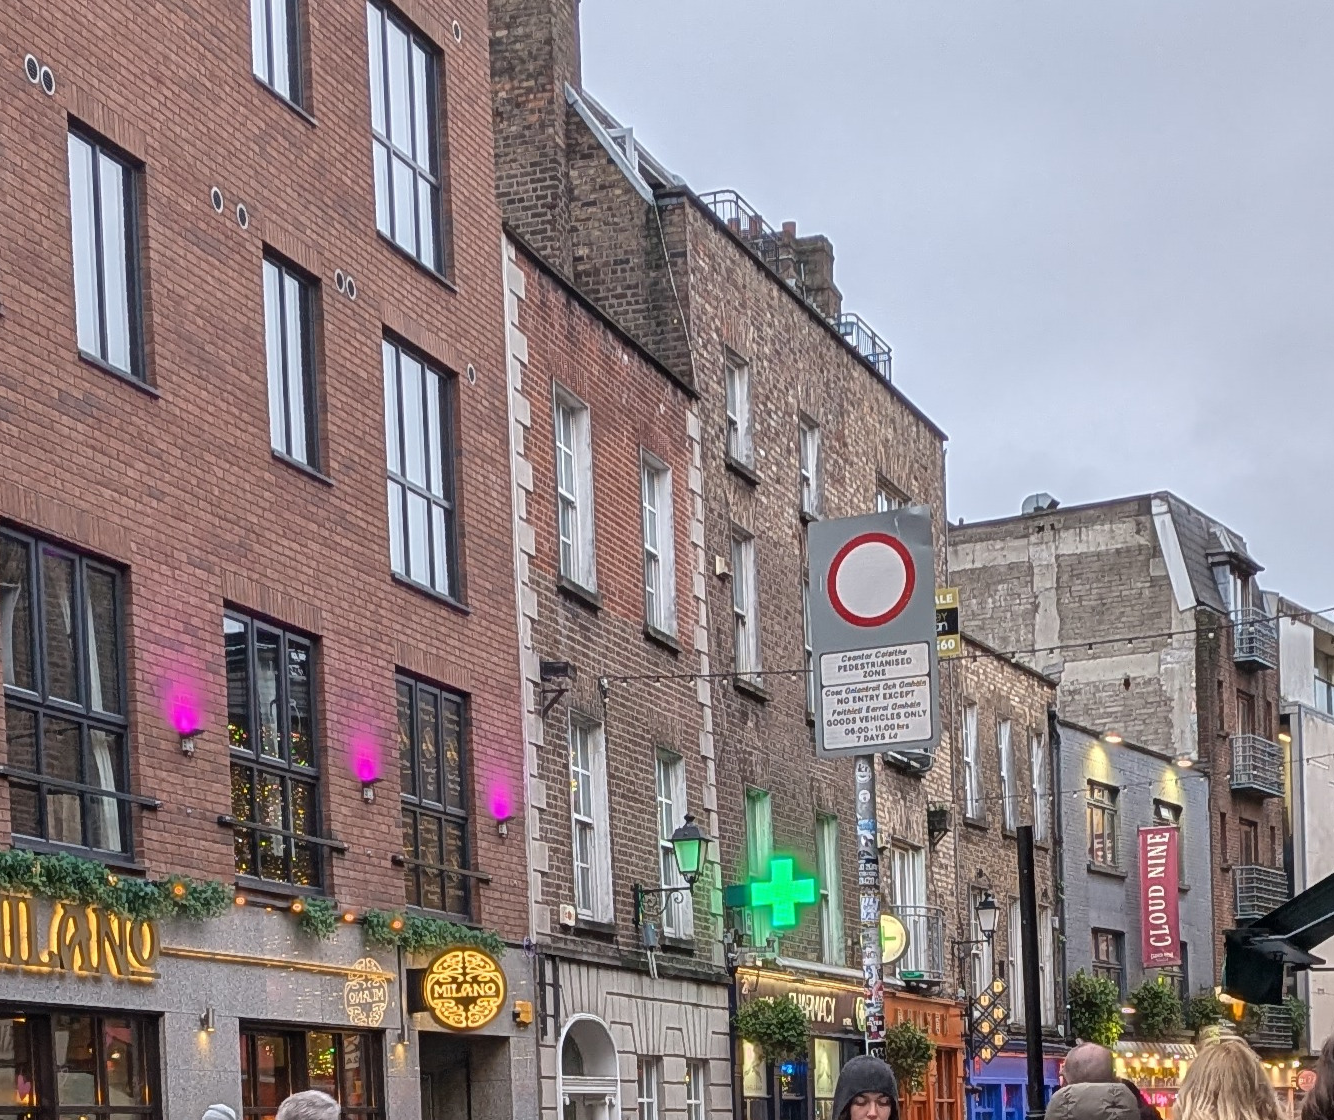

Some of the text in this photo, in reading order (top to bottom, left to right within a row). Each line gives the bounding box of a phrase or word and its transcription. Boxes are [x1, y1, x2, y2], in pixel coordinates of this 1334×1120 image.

[837, 657, 912, 673] PEDESTRIANISED
[863, 669, 887, 678] ZONE
[837, 690, 915, 705] NO ENTRY EXCEPT
[827, 709, 927, 727] GOODS VEHICLES ONLY
[856, 735, 861, 743] 7
[863, 733, 886, 742] DAYS
[1147, 832, 1170, 878] NINE
[1149, 885, 1172, 947] CLOUD
[433, 982, 497, 998] MILANO
